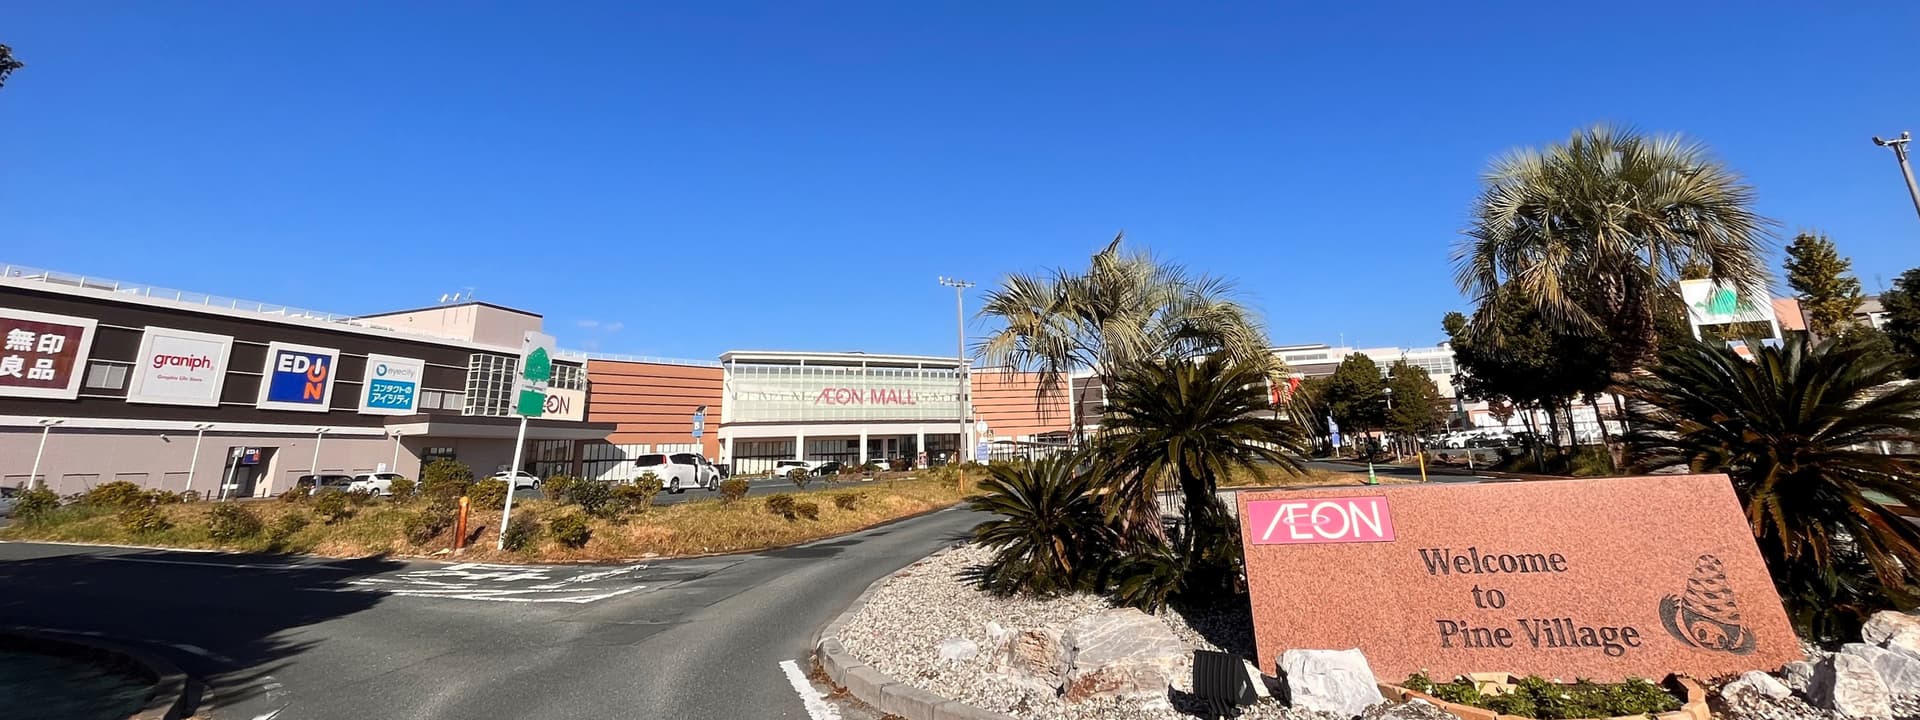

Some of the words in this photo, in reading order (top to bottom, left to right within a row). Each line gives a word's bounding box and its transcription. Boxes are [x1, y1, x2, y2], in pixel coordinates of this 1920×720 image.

[4, 328, 66, 356] 無印
[0, 355, 56, 381] 良品
[153, 354, 211, 372] graniph
[370, 392, 411, 406] アイシティ
[372, 383, 413, 394] コンタクトの
[870, 388, 917, 405] MALL
[543, 394, 570, 414] ON
[1418, 546, 1567, 576] Welcome
[1470, 583, 1506, 609] to
[1436, 618, 1514, 649] Pine
[1517, 617, 1641, 656] Village
